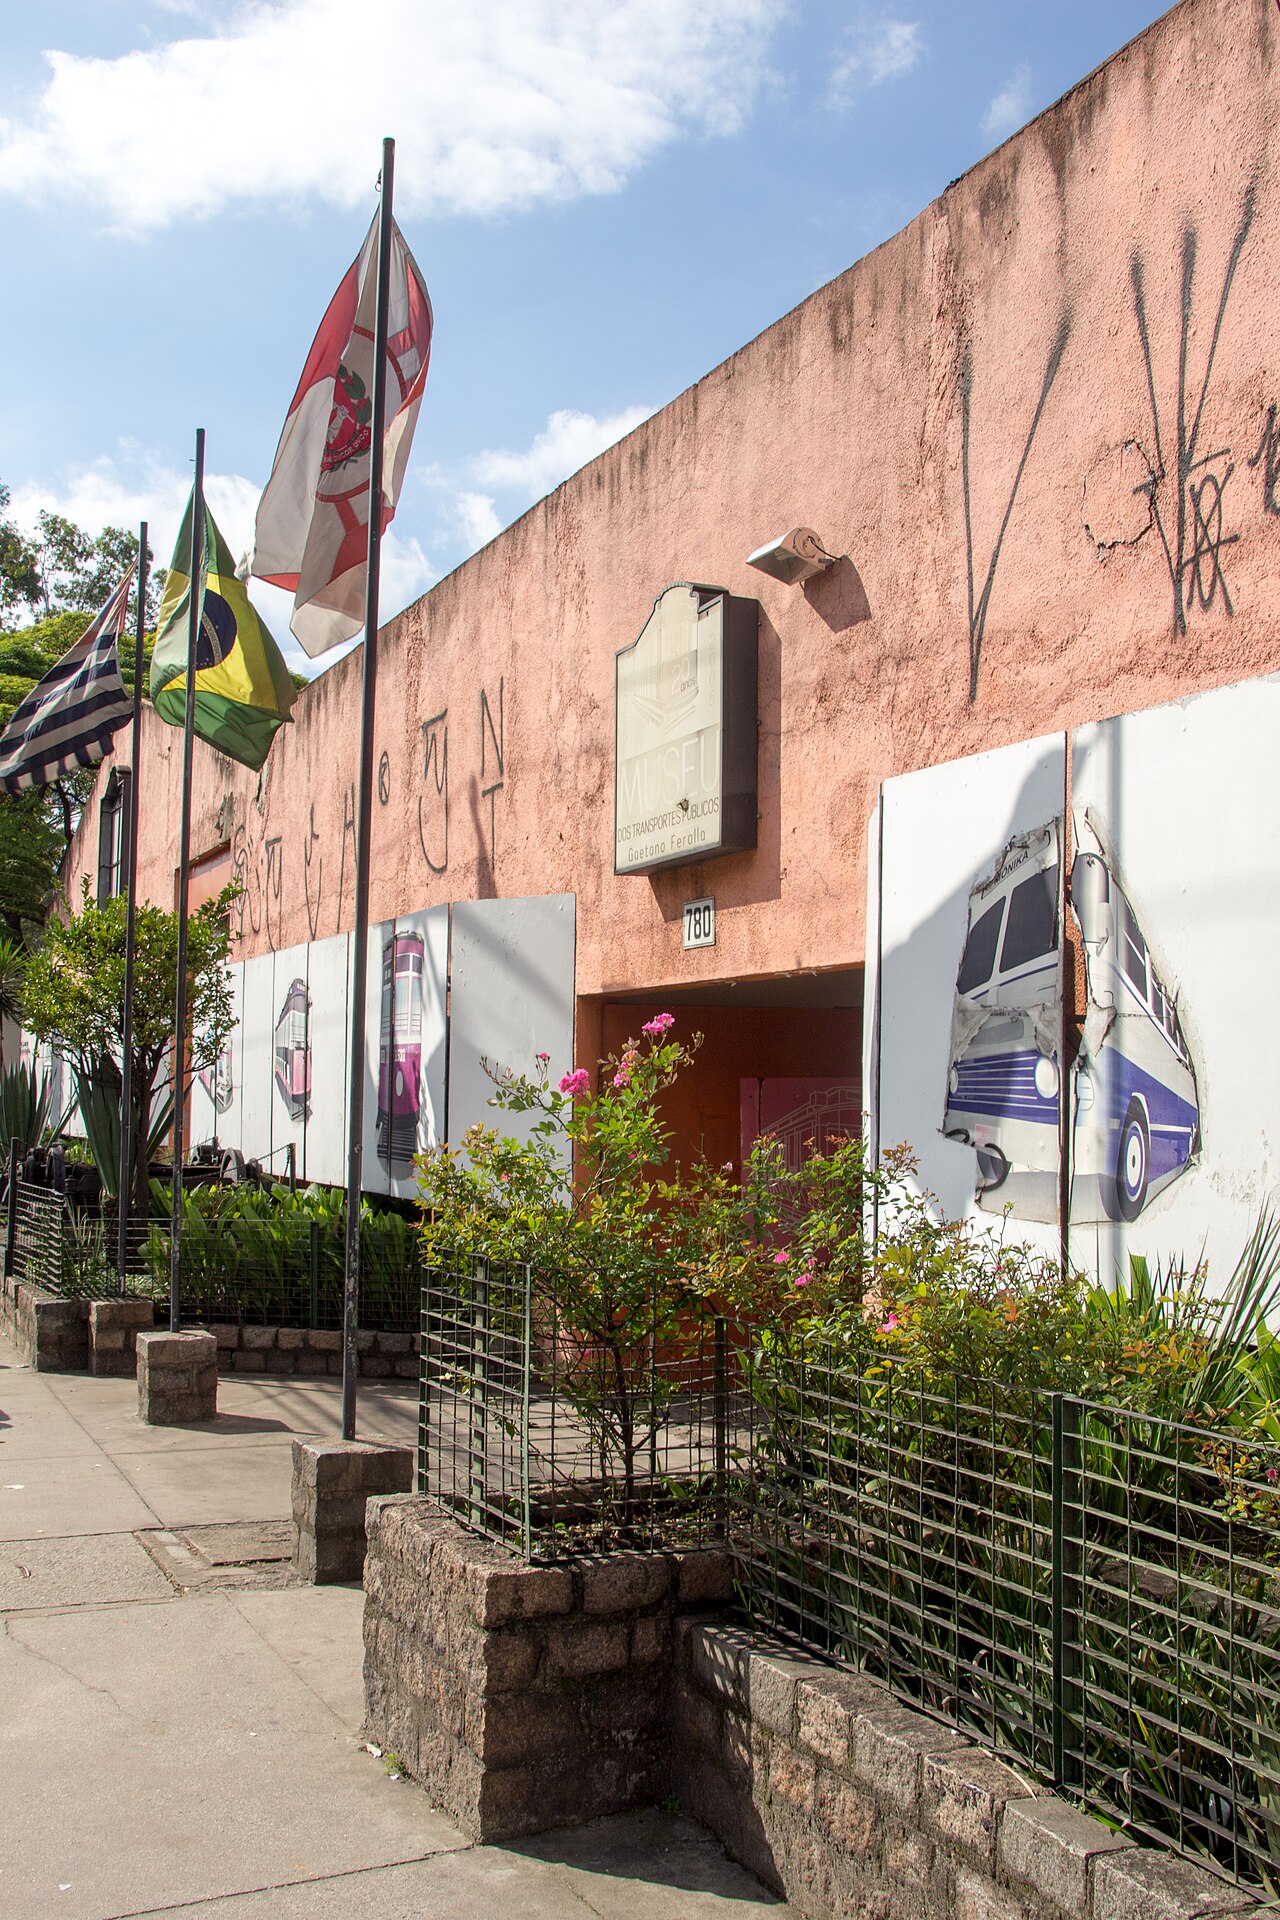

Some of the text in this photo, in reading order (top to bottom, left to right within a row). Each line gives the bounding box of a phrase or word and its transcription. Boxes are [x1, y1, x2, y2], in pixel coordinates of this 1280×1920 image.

[671, 656, 690, 695] 20
[680, 676, 696, 692] anos
[619, 728, 720, 818] MUSEU
[617, 825, 631, 843] DOS
[632, 810, 681, 838] TRANSPORTES
[628, 842, 666, 862] Gaetano
[686, 904, 711, 942] 780
